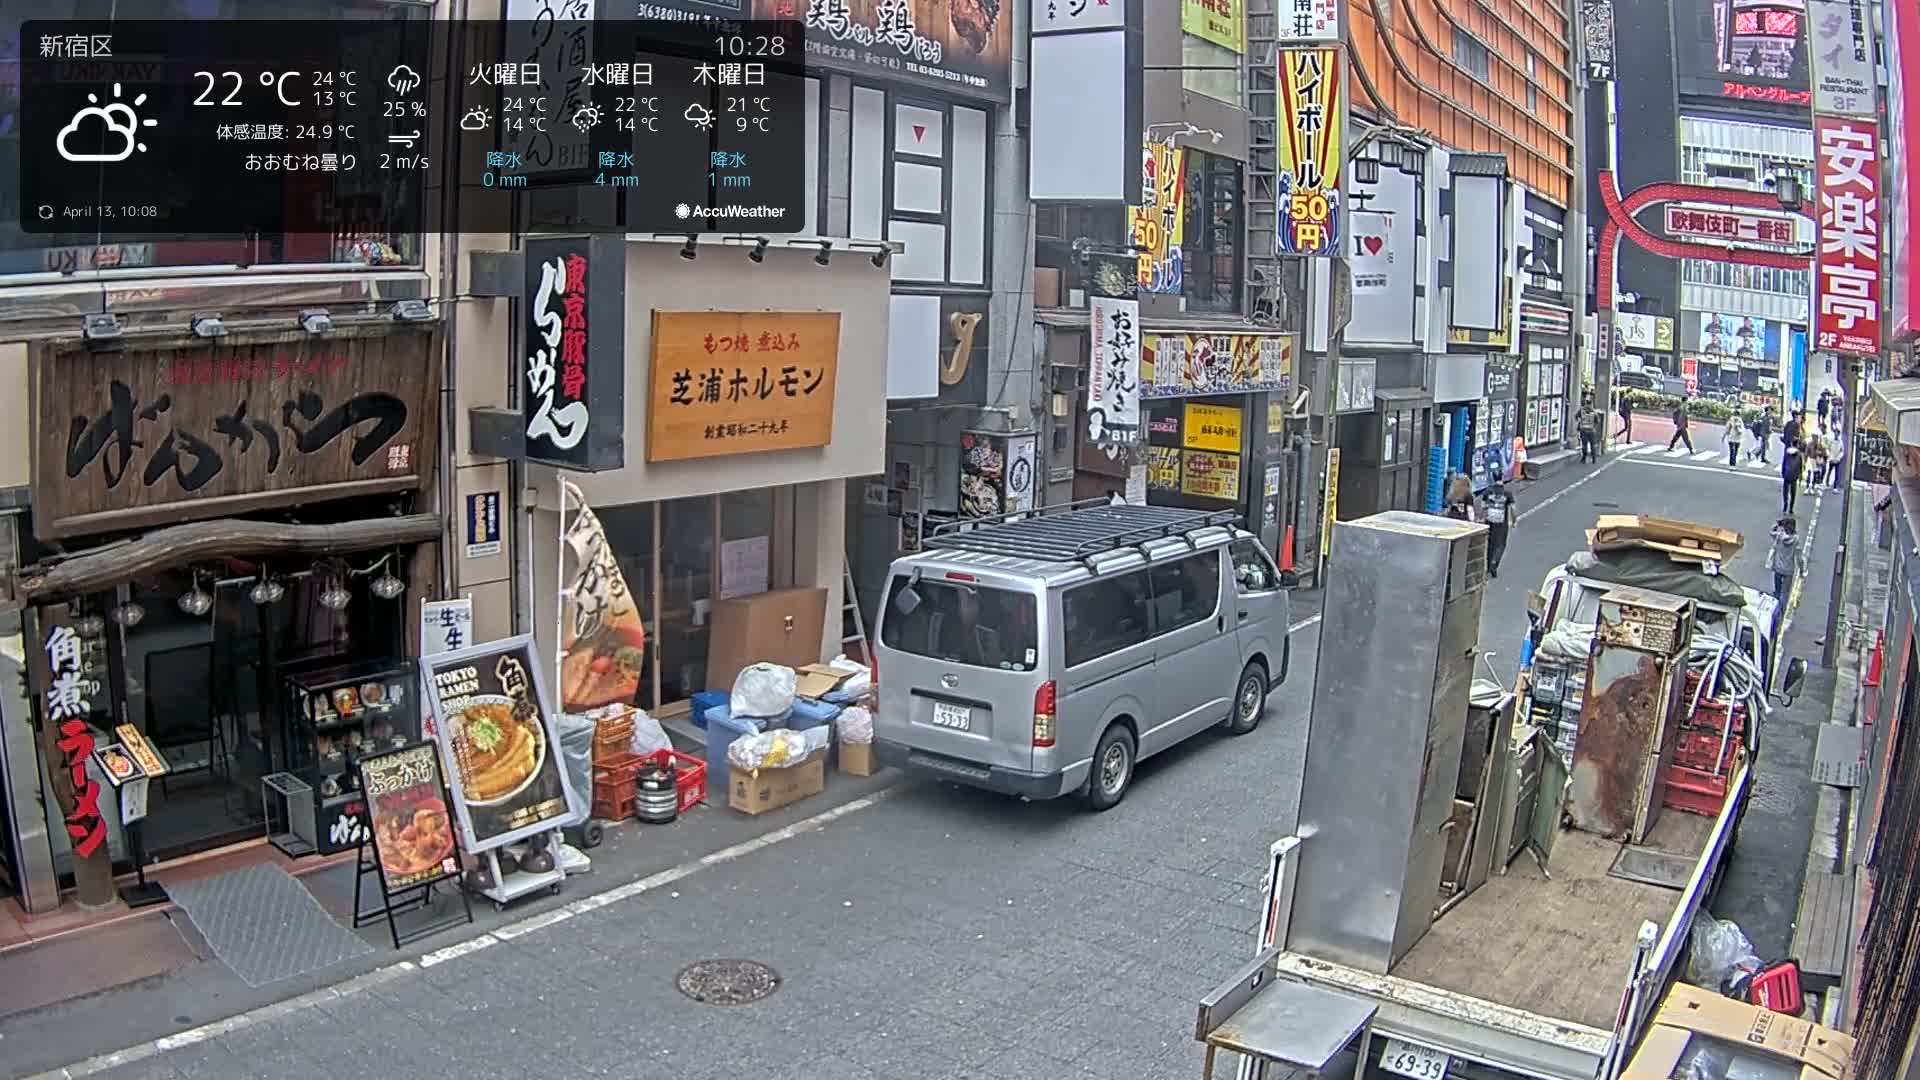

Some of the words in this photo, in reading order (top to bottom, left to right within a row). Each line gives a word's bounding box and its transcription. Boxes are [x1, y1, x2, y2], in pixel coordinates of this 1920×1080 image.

[1590, 62, 1611, 78] 7F
[1297, 53, 1321, 189] ハイボール
[1671, 210, 1791, 242] 歌舞伎町一番街
[1820, 125, 1876, 329] 安楽亭
[703, 332, 751, 354] もつ焼
[1819, 332, 1838, 348] 2F
[1106, 309, 1136, 413] お好み焼き
[669, 365, 826, 406] 芝浦ホルモン
[435, 666, 478, 687] TOKYO
[440, 679, 480, 700] RAMEN
[1394, 1052, 1443, 1079] 69-39
